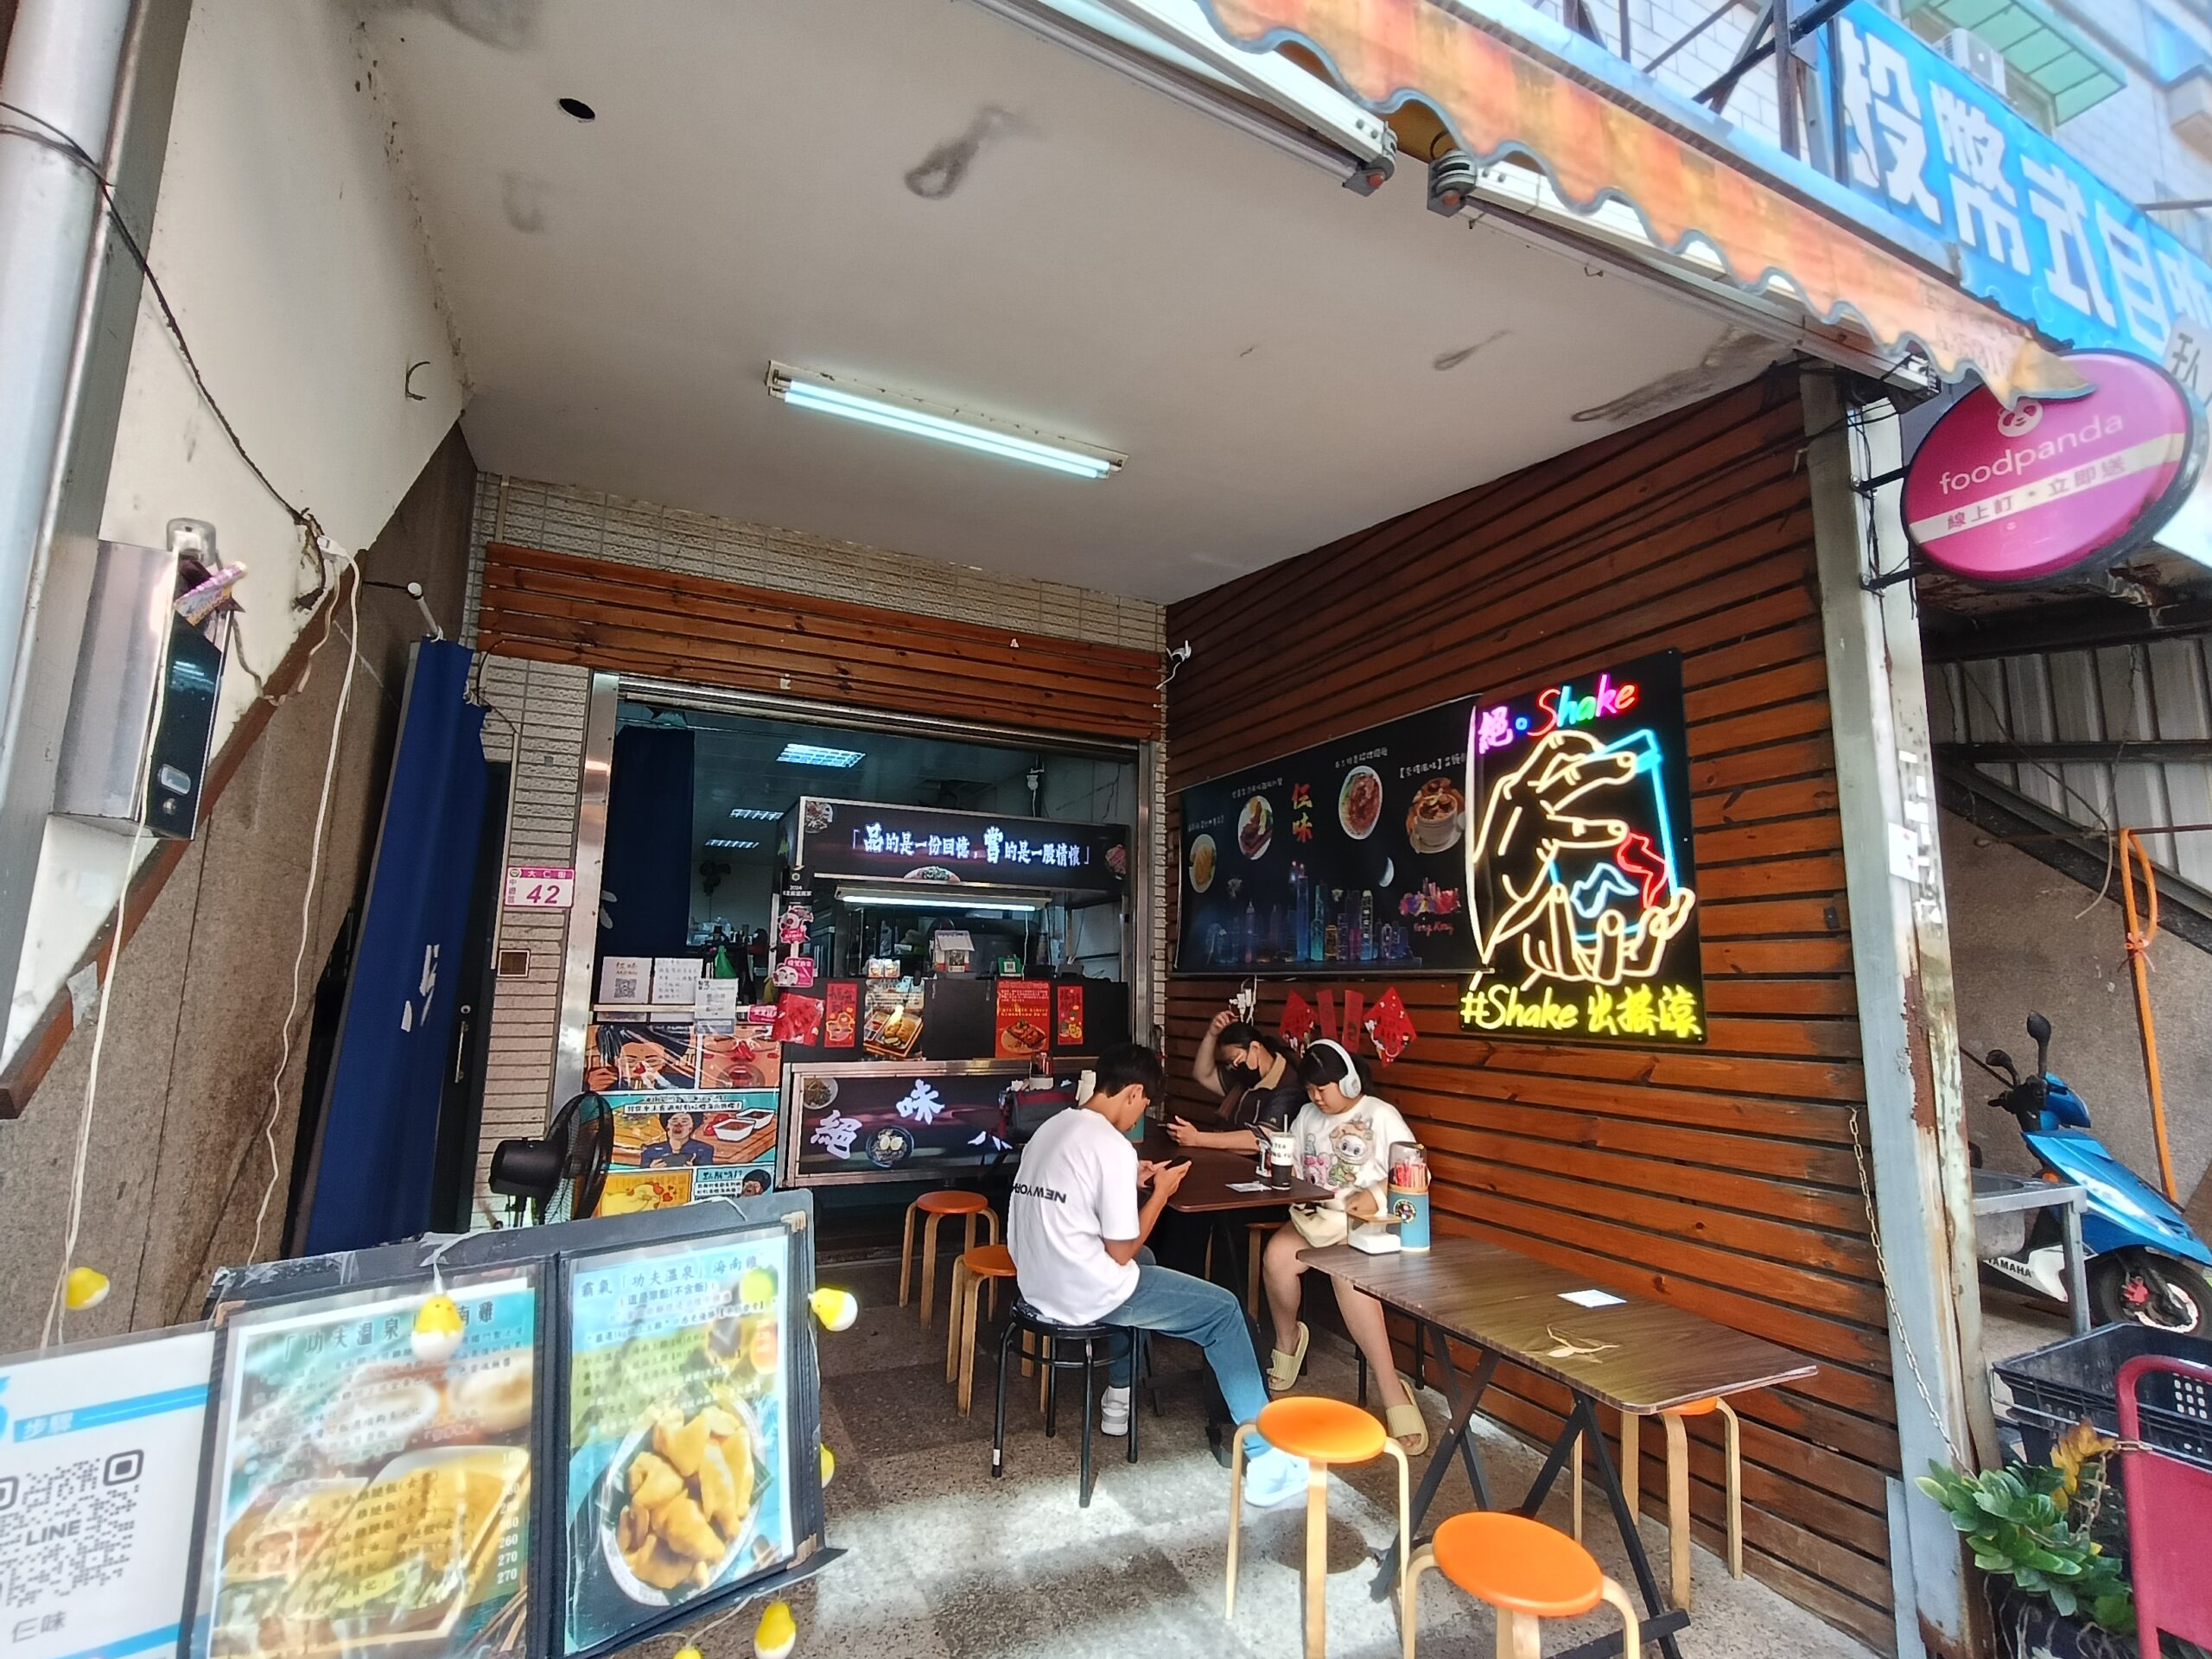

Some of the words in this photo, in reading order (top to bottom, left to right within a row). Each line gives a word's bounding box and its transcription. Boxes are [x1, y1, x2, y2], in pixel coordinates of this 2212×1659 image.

[1939, 415, 2124, 495] foodpanda
[1528, 674, 1637, 736] Shake
[526, 884, 561, 904] 42
[1460, 983, 1580, 1030] #Shake
[25, 1519, 82, 1547] LINE
[499, 1535, 518, 1548] 260
[497, 1551, 518, 1567] 270
[496, 1567, 518, 1585] 270
